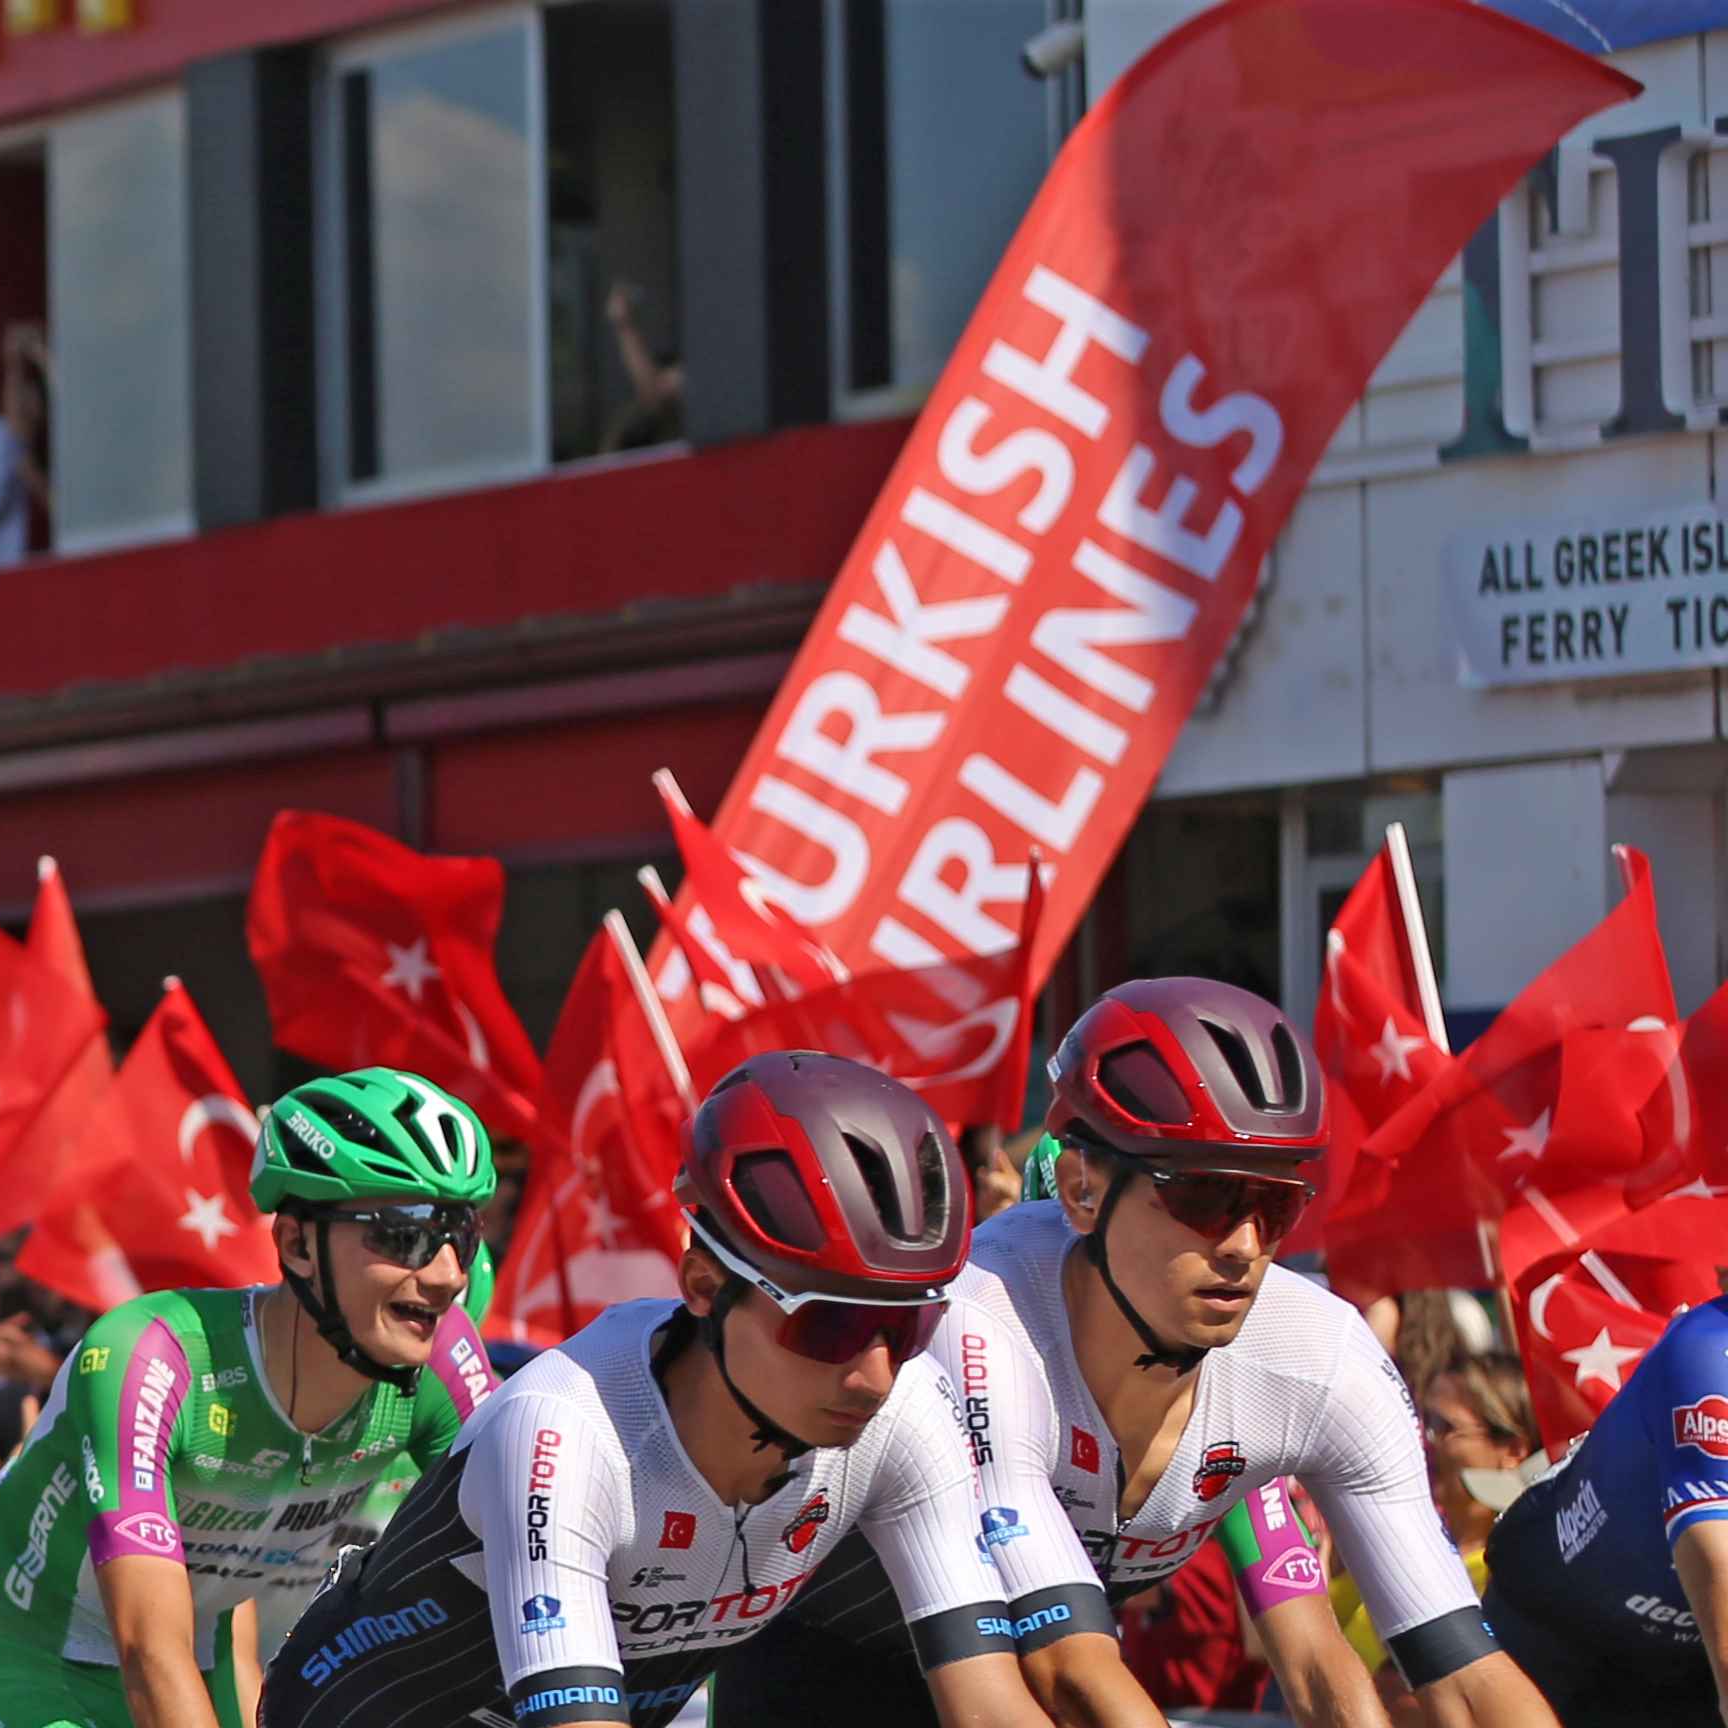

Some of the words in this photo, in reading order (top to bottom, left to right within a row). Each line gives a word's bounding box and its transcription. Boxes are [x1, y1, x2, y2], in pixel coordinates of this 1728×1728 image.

[1479, 540, 1543, 597] ALL
[1553, 525, 1670, 587] GREEK
[1681, 519, 1728, 576] ISL
[1500, 603, 1629, 668] FERRY
[1666, 594, 1728, 653] TIC
[961, 1333, 994, 1467] SPORTOTO
[527, 1428, 562, 1562] SPORTOTO
[1556, 1479, 1602, 1553] Alpecin
[139, 1521, 178, 1549] FTC
[1284, 1559, 1321, 1581] FTC
[610, 1561, 819, 1636] PORTOT
[301, 1598, 448, 1687] SHIMANO
[513, 1685, 620, 1721] SHIMANO
